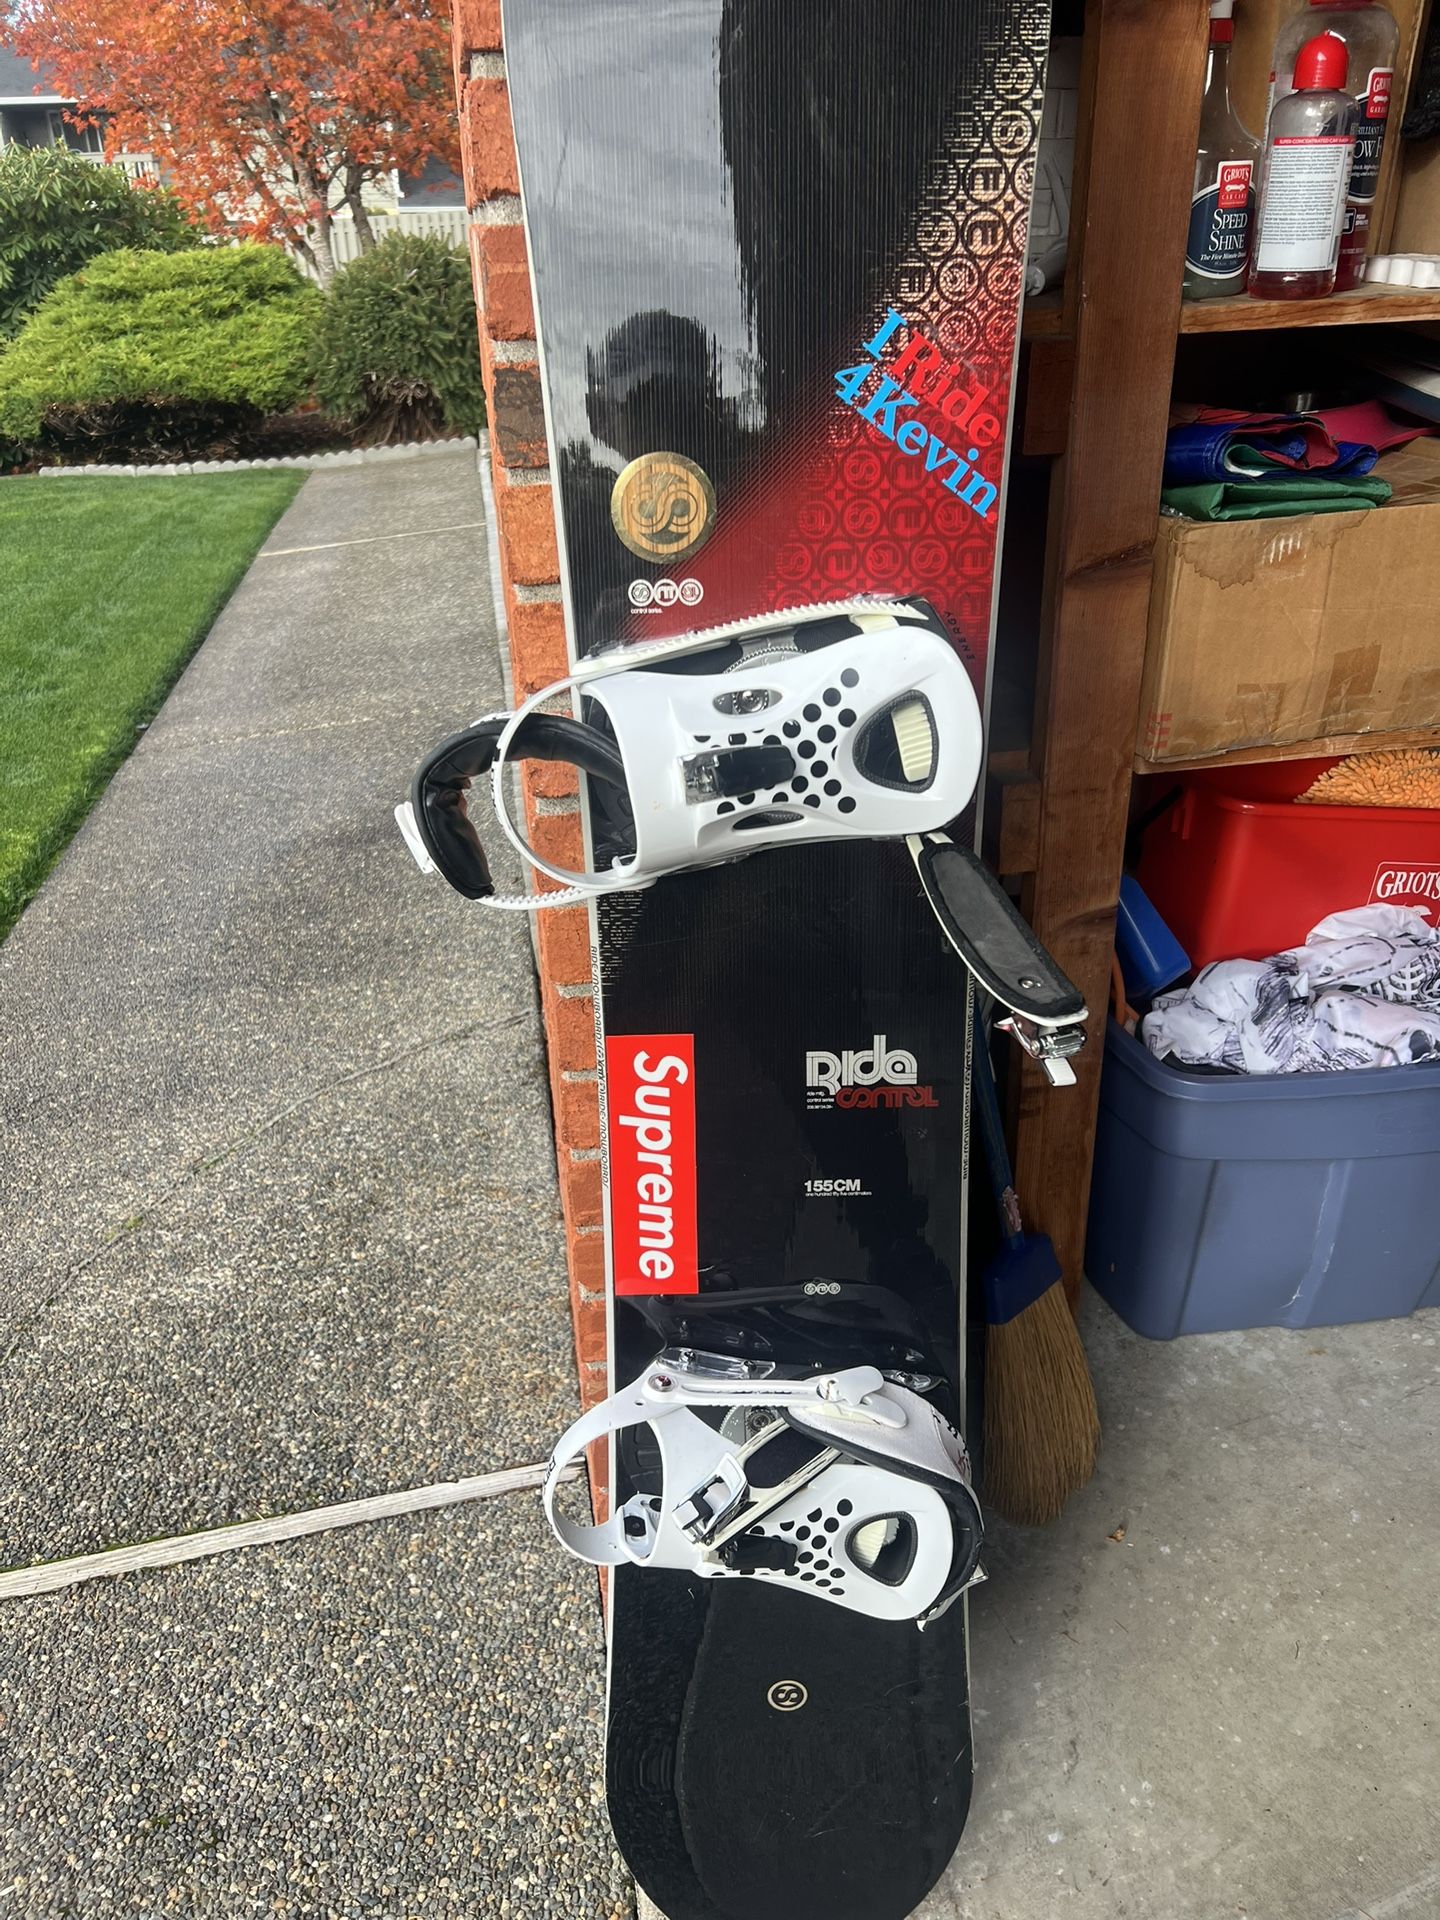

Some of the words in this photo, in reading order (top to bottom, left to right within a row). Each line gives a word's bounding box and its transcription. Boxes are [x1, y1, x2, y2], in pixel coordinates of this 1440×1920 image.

[1212, 208, 1248, 230] SPEED
[1208, 230, 1245, 251] SHINE
[862, 306, 907, 360] I
[888, 329, 1000, 447] Ride
[618, 1050, 689, 1279] Supreme
[804, 1179, 861, 1192] 155CM
